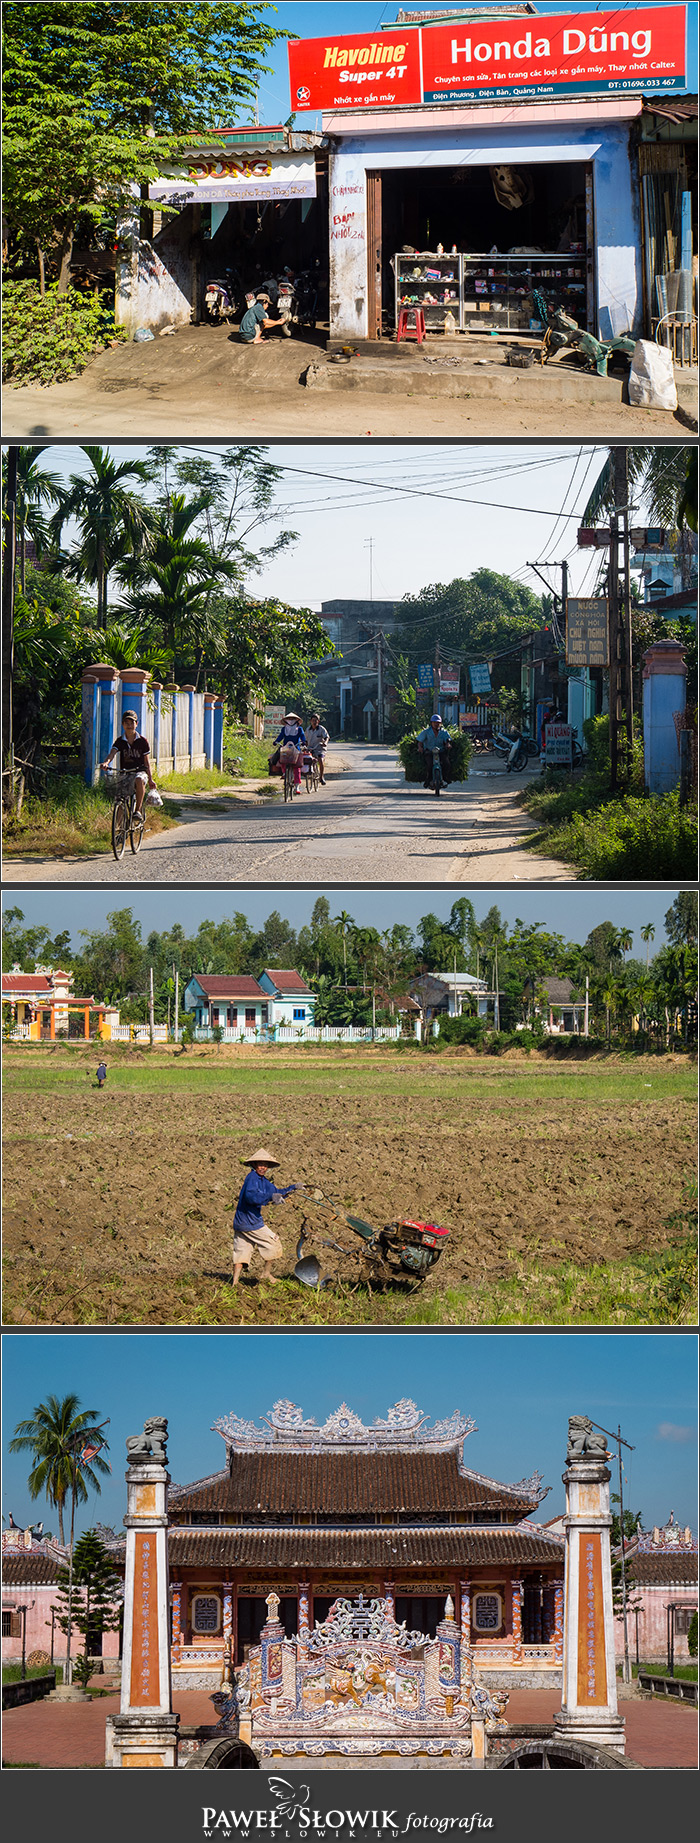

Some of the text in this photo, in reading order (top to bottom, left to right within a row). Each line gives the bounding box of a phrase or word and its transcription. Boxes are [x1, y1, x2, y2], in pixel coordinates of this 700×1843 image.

[451, 26, 652, 64] Honda Dũng
[323, 43, 406, 68] Havoline
[339, 66, 407, 84] Super 4T
[434, 76, 460, 84] Chuyên
[508, 70, 528, 79] trang
[544, 68, 558, 76] loại
[588, 66, 606, 74] máy,
[608, 64, 626, 72] Thay
[629, 62, 648, 70] nhớt
[622, 80, 660, 88] 01696.033
[334, 95, 352, 104] Nhớt
[380, 93, 395, 102] máy
[433, 92, 448, 100] Điện
[513, 87, 536, 95] Quảng
